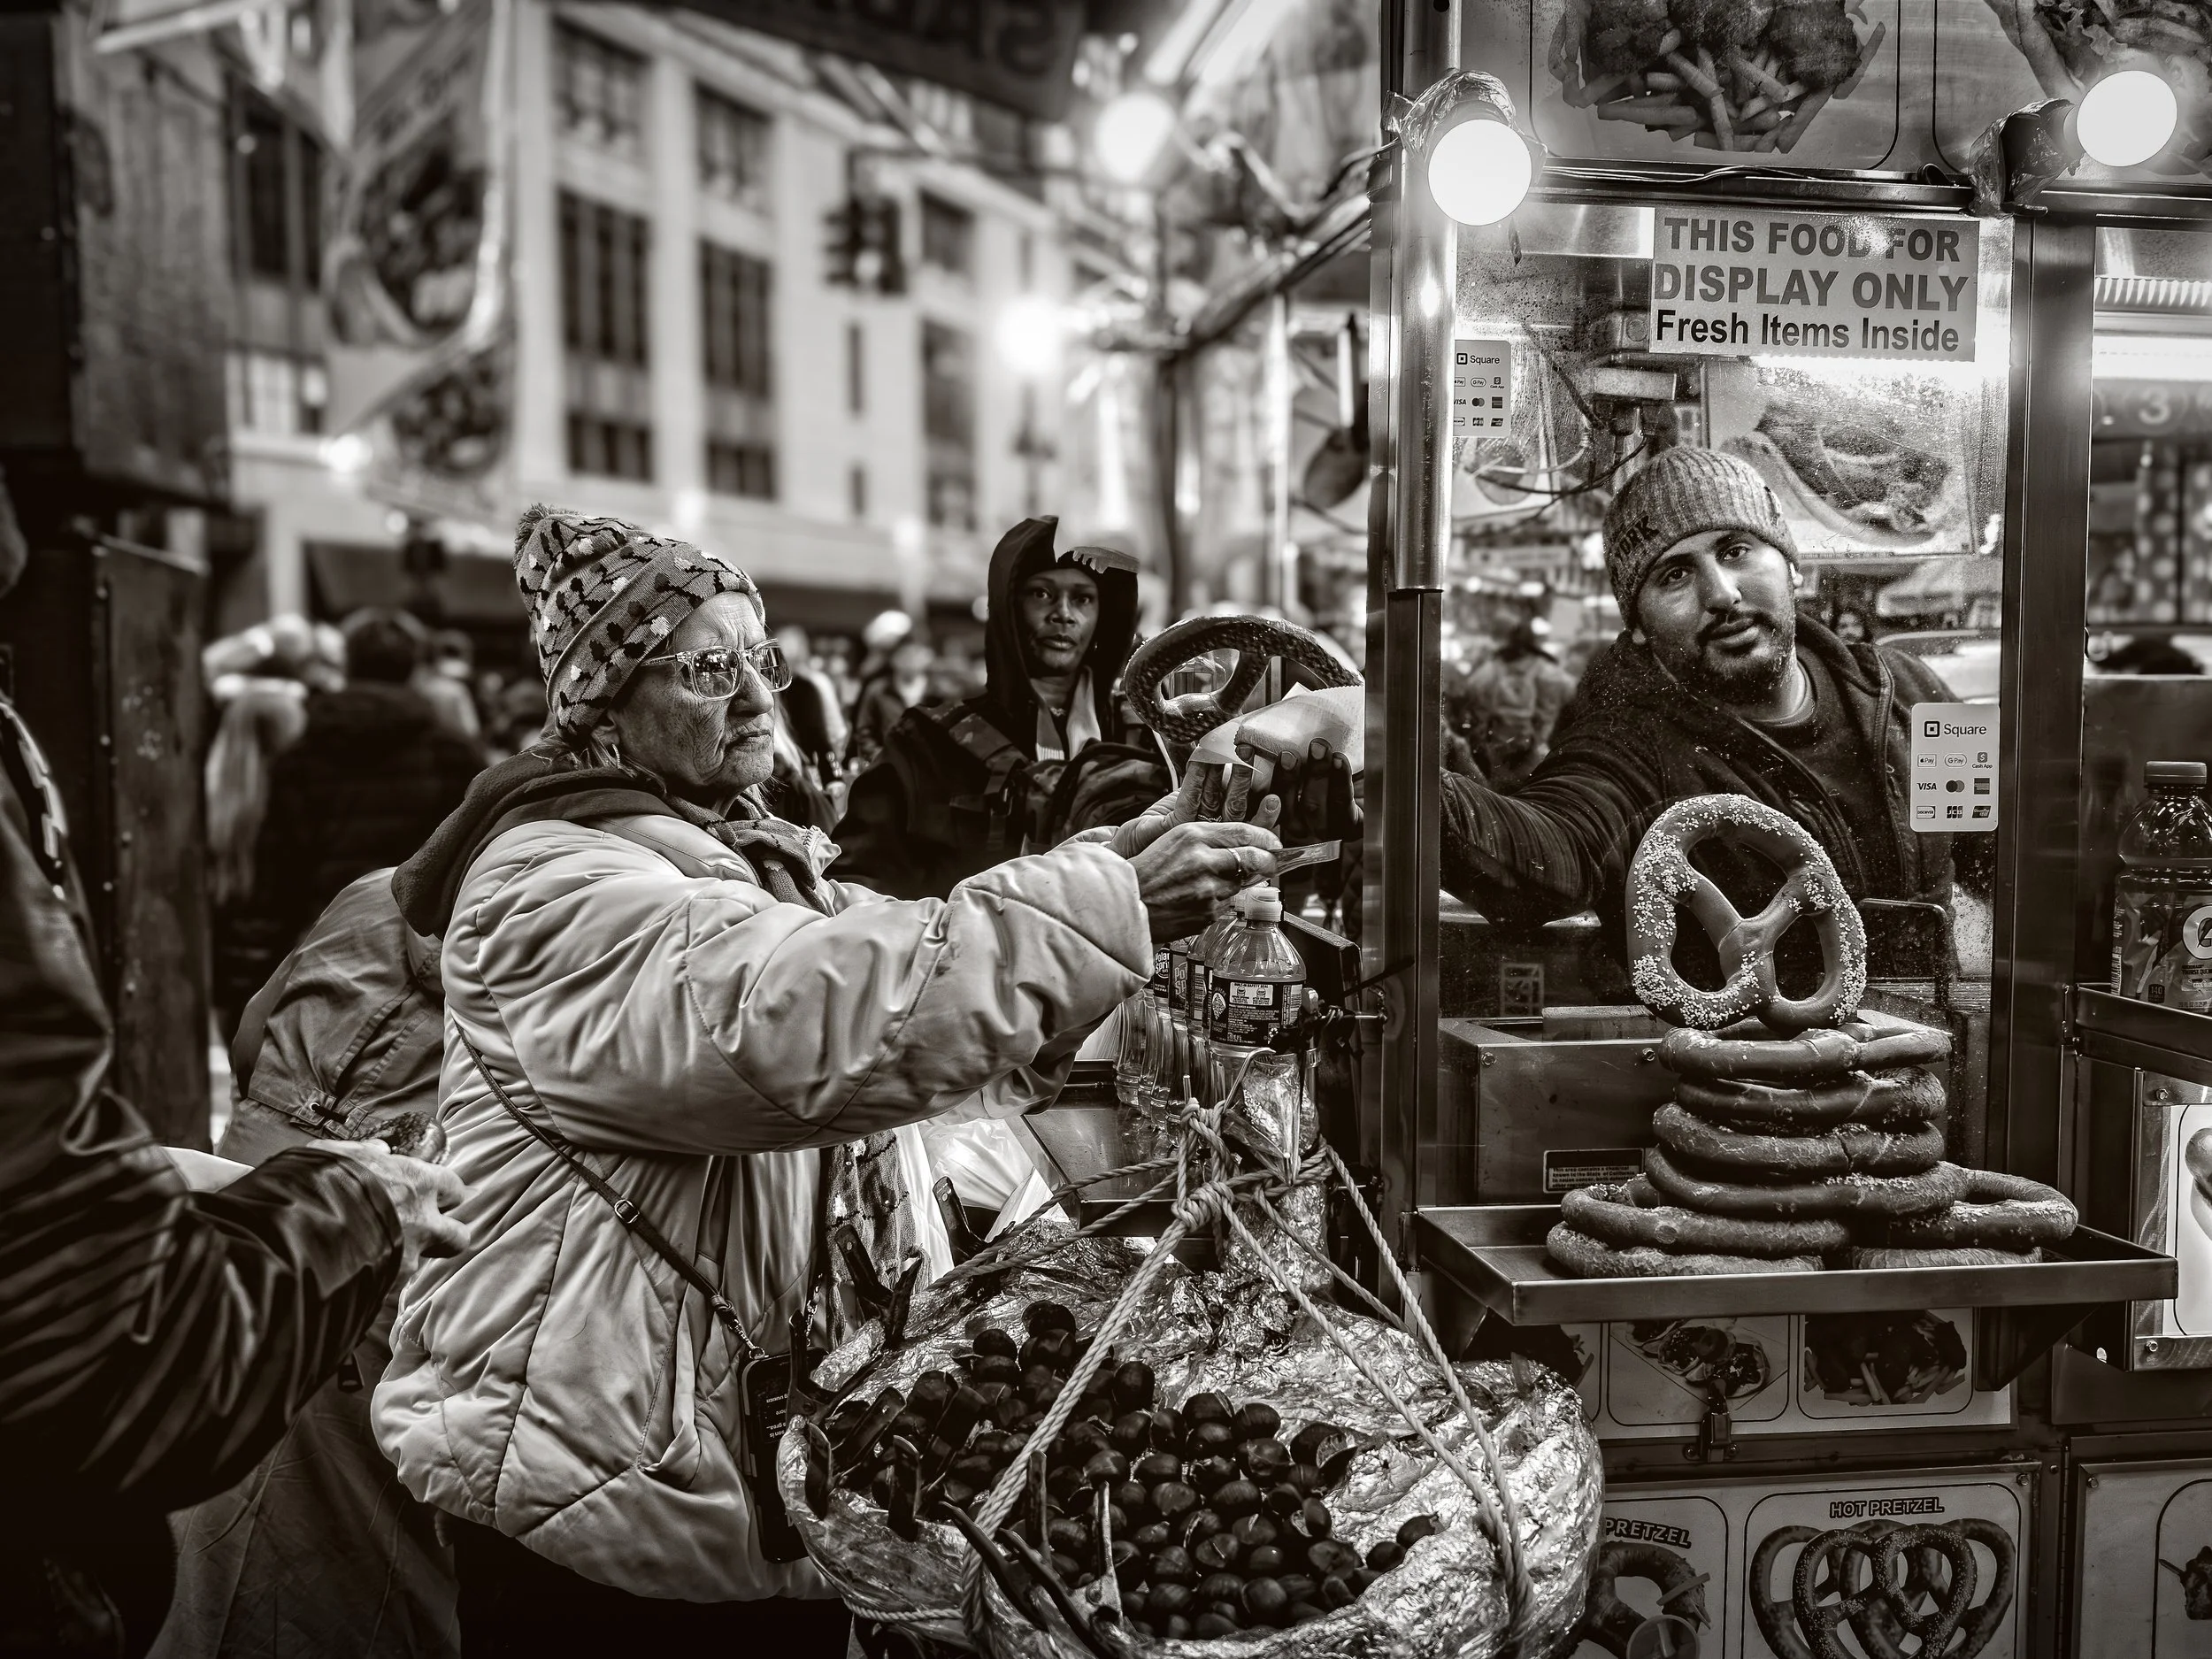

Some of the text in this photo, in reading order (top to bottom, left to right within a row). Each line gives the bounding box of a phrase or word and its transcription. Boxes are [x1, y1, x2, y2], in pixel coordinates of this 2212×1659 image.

[1663, 218, 1961, 263] THIS FOOD FOR
[1655, 264, 1969, 311] DISPLAY ONLY
[1655, 310, 1959, 352] Fresh Items Inside
[1470, 355, 1501, 365] Square
[1944, 723, 1987, 738] Square
[1830, 1496, 1945, 1518] HOT PRETZEL
[1606, 1517, 1692, 1549] PRETZEL
